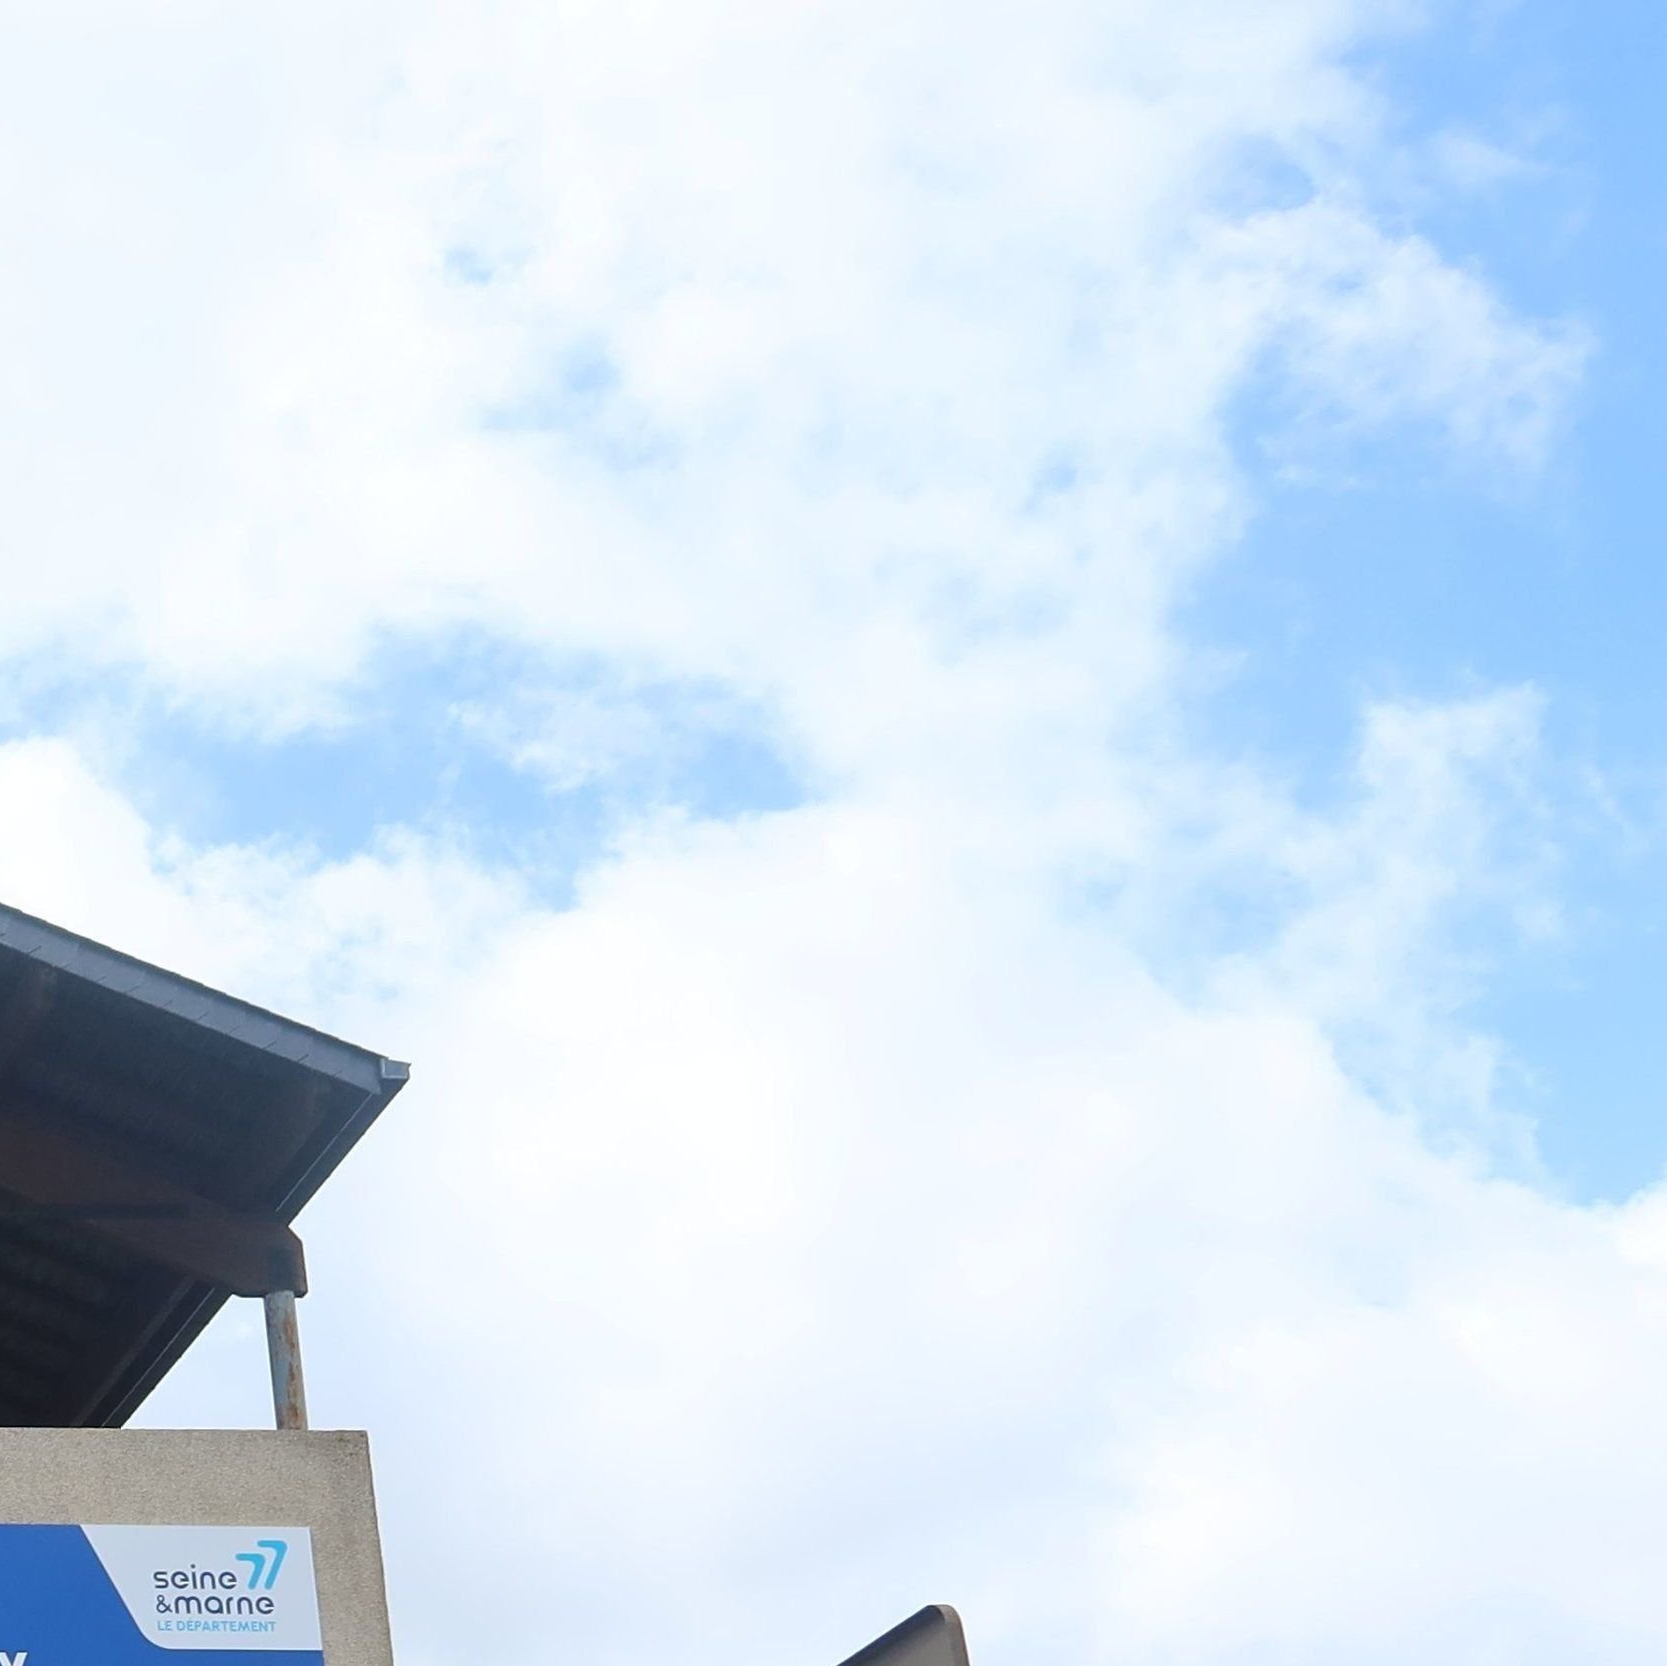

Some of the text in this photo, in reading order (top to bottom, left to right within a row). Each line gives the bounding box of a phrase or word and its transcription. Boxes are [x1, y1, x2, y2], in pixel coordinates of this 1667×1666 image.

[153, 1563, 238, 1590] seine
[155, 1594, 276, 1615] &marne
[157, 1618, 277, 1633] LE DÉPARTEMENT
